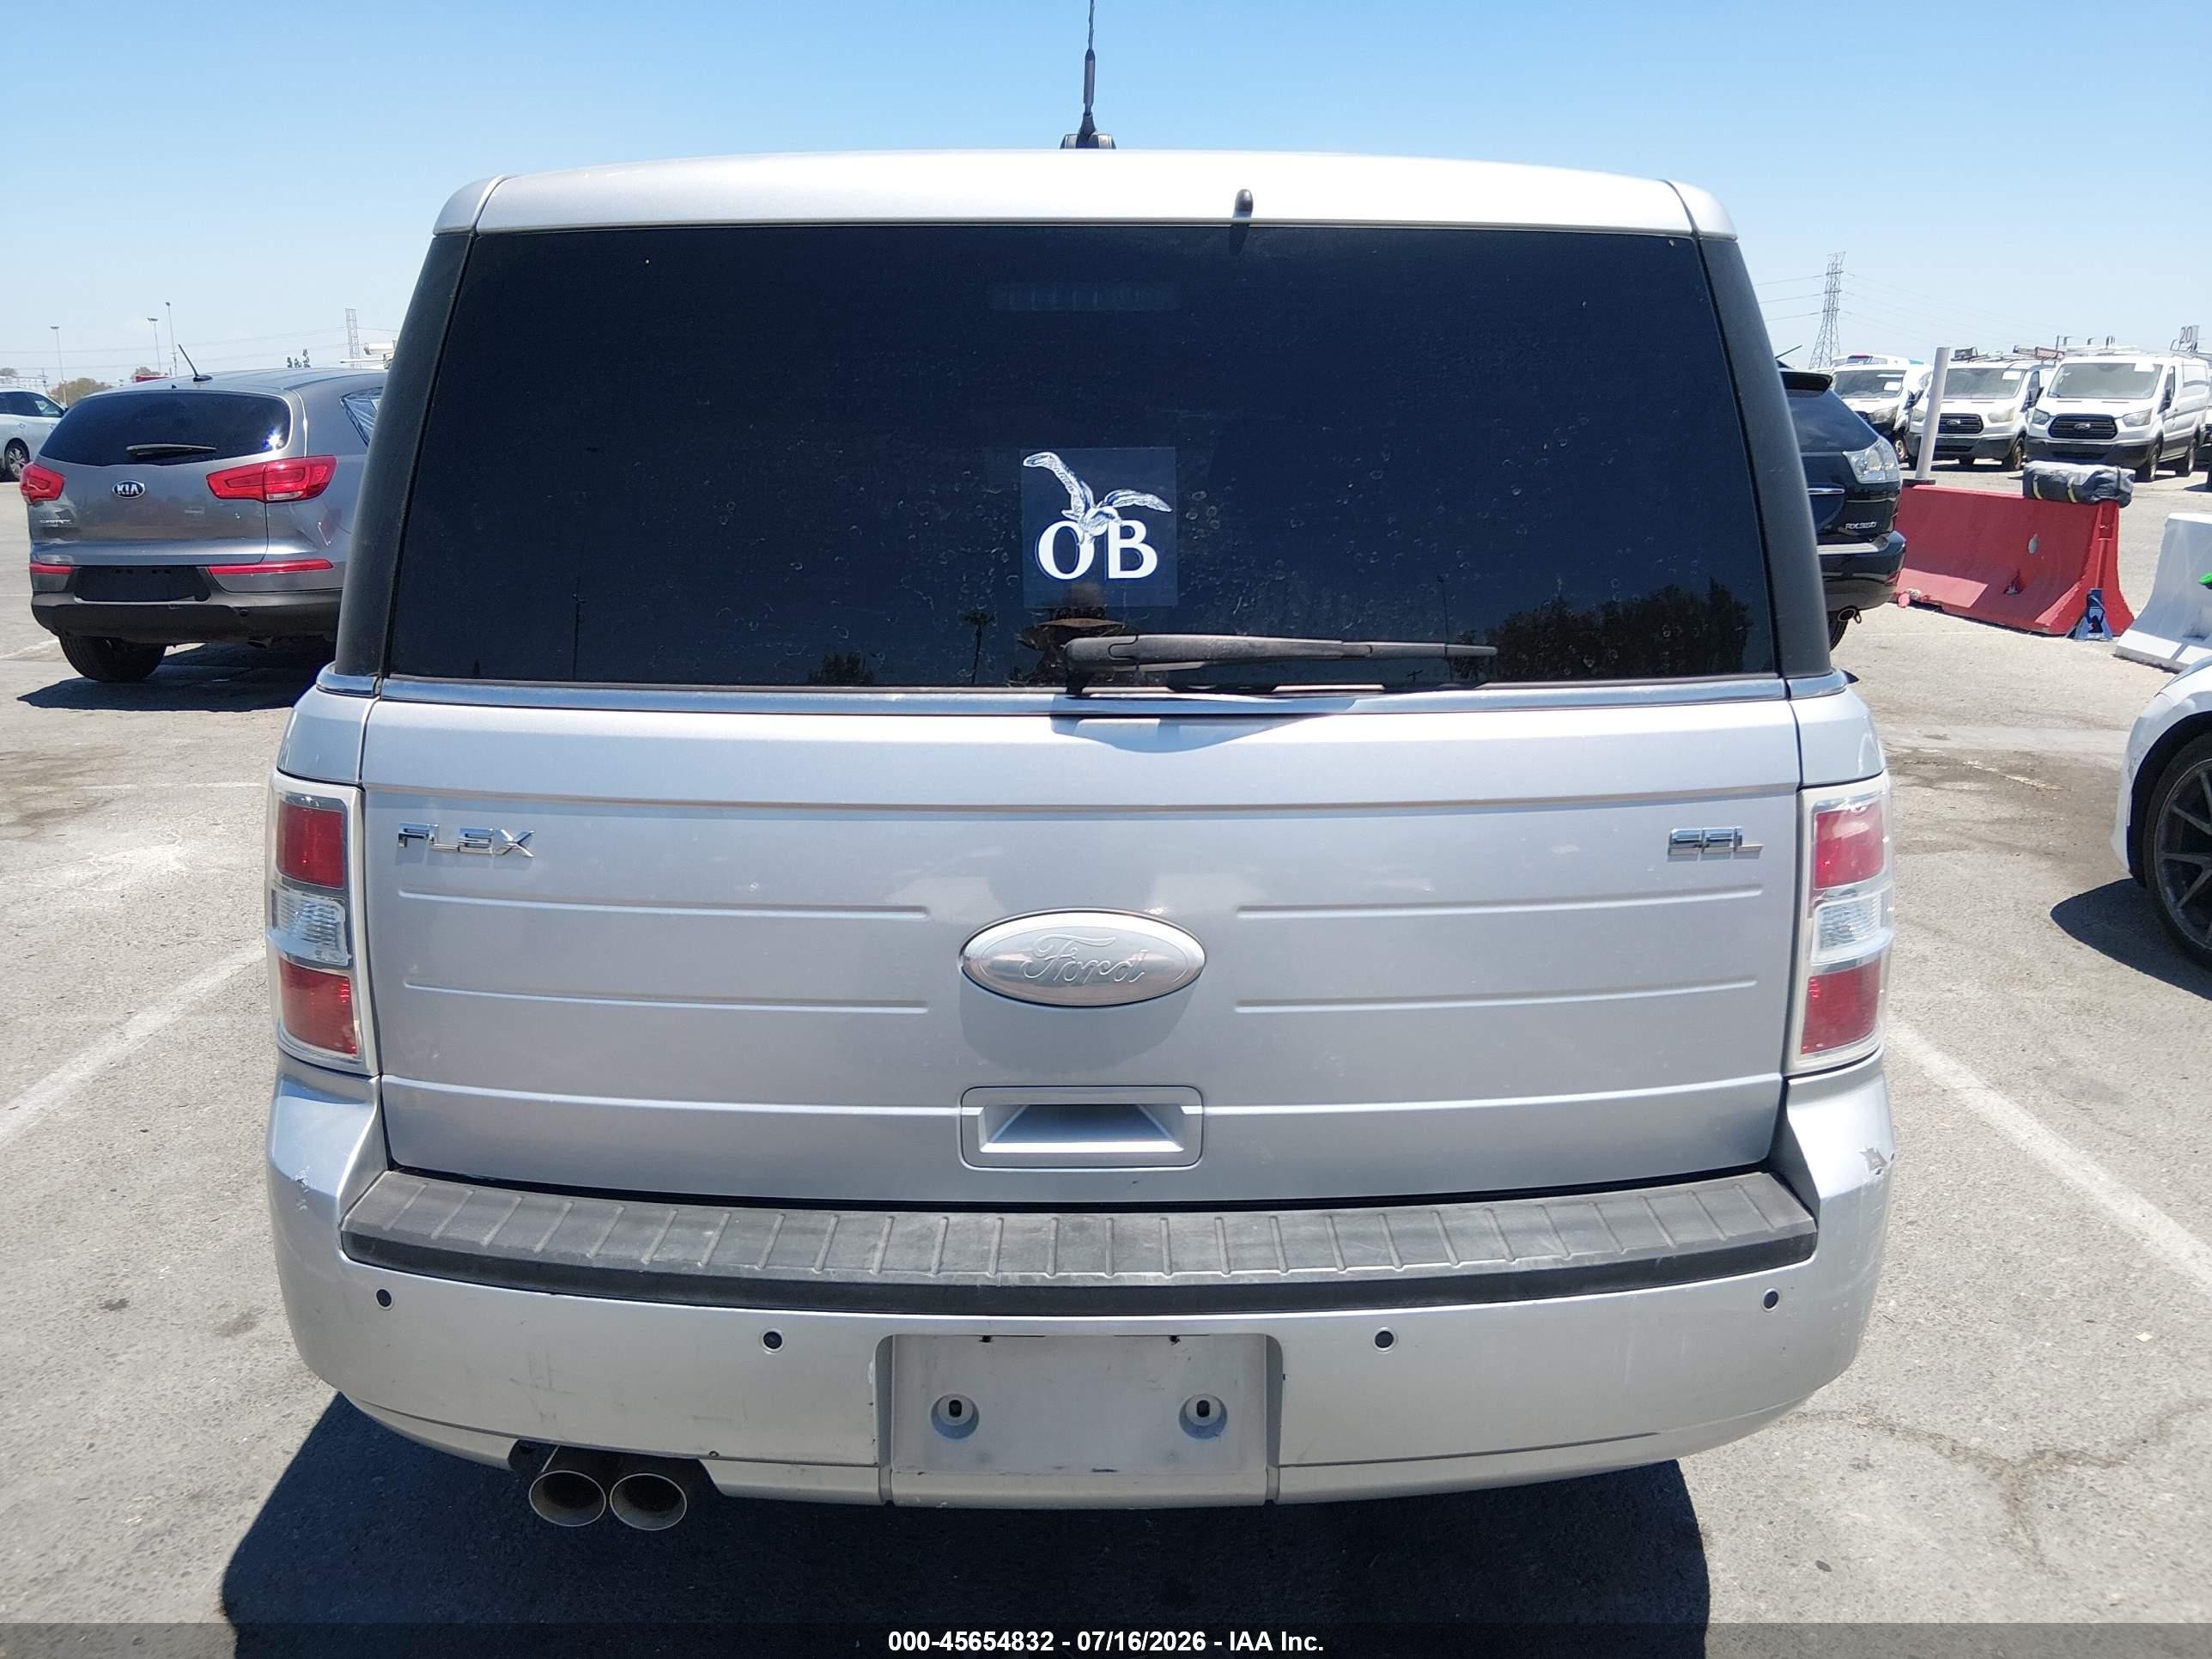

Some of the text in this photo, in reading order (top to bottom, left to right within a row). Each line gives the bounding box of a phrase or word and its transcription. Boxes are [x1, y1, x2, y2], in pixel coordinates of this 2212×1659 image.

[117, 483, 140, 495] KIA
[1037, 520, 1158, 580] OB
[398, 822, 536, 857] FLEX
[1019, 933, 1147, 982] Ford
